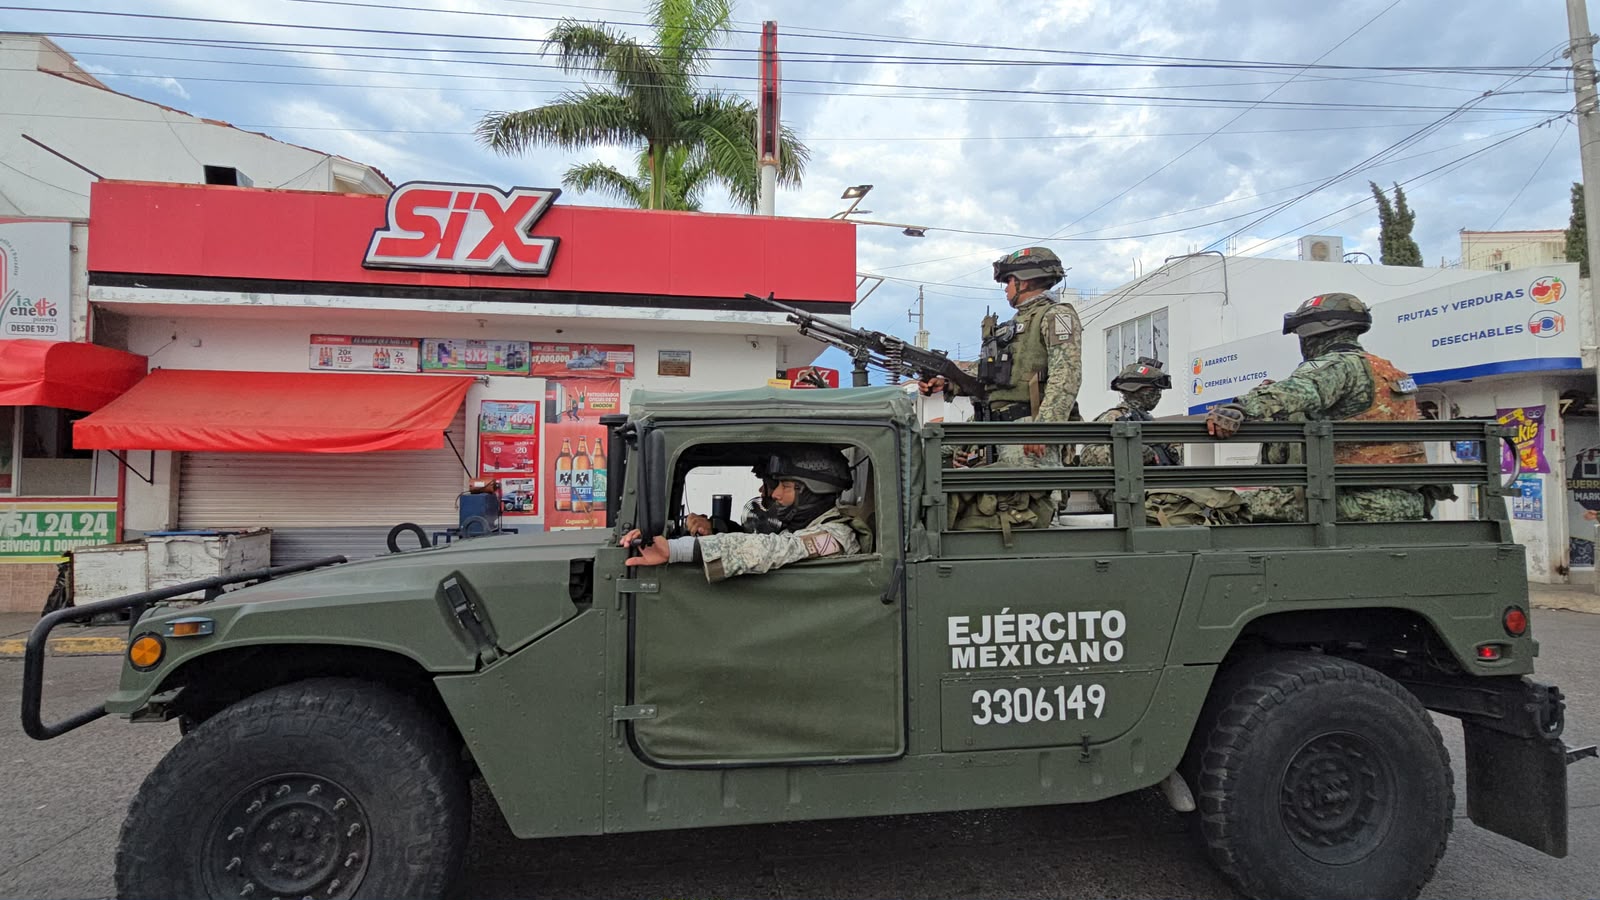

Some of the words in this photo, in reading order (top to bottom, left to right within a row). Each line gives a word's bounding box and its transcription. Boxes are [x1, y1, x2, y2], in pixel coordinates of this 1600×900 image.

[1397, 307, 1438, 323] FRUTAS
[1441, 304, 1449, 313] Y
[1452, 289, 1524, 311] VERDURAS
[11, 324, 35, 332] DESDE
[36, 324, 55, 333] 1979
[1432, 324, 1524, 348] DESECHABLES
[1204, 354, 1238, 367] ABARROTES
[1204, 377, 1233, 388] CREMERÍA
[1239, 371, 1268, 382] LACTEOS
[43, 539, 51, 552] A
[948, 607, 1126, 645] EJÉRCITO
[952, 640, 1124, 669] MEXICANO
[972, 684, 1106, 725] 3306149
